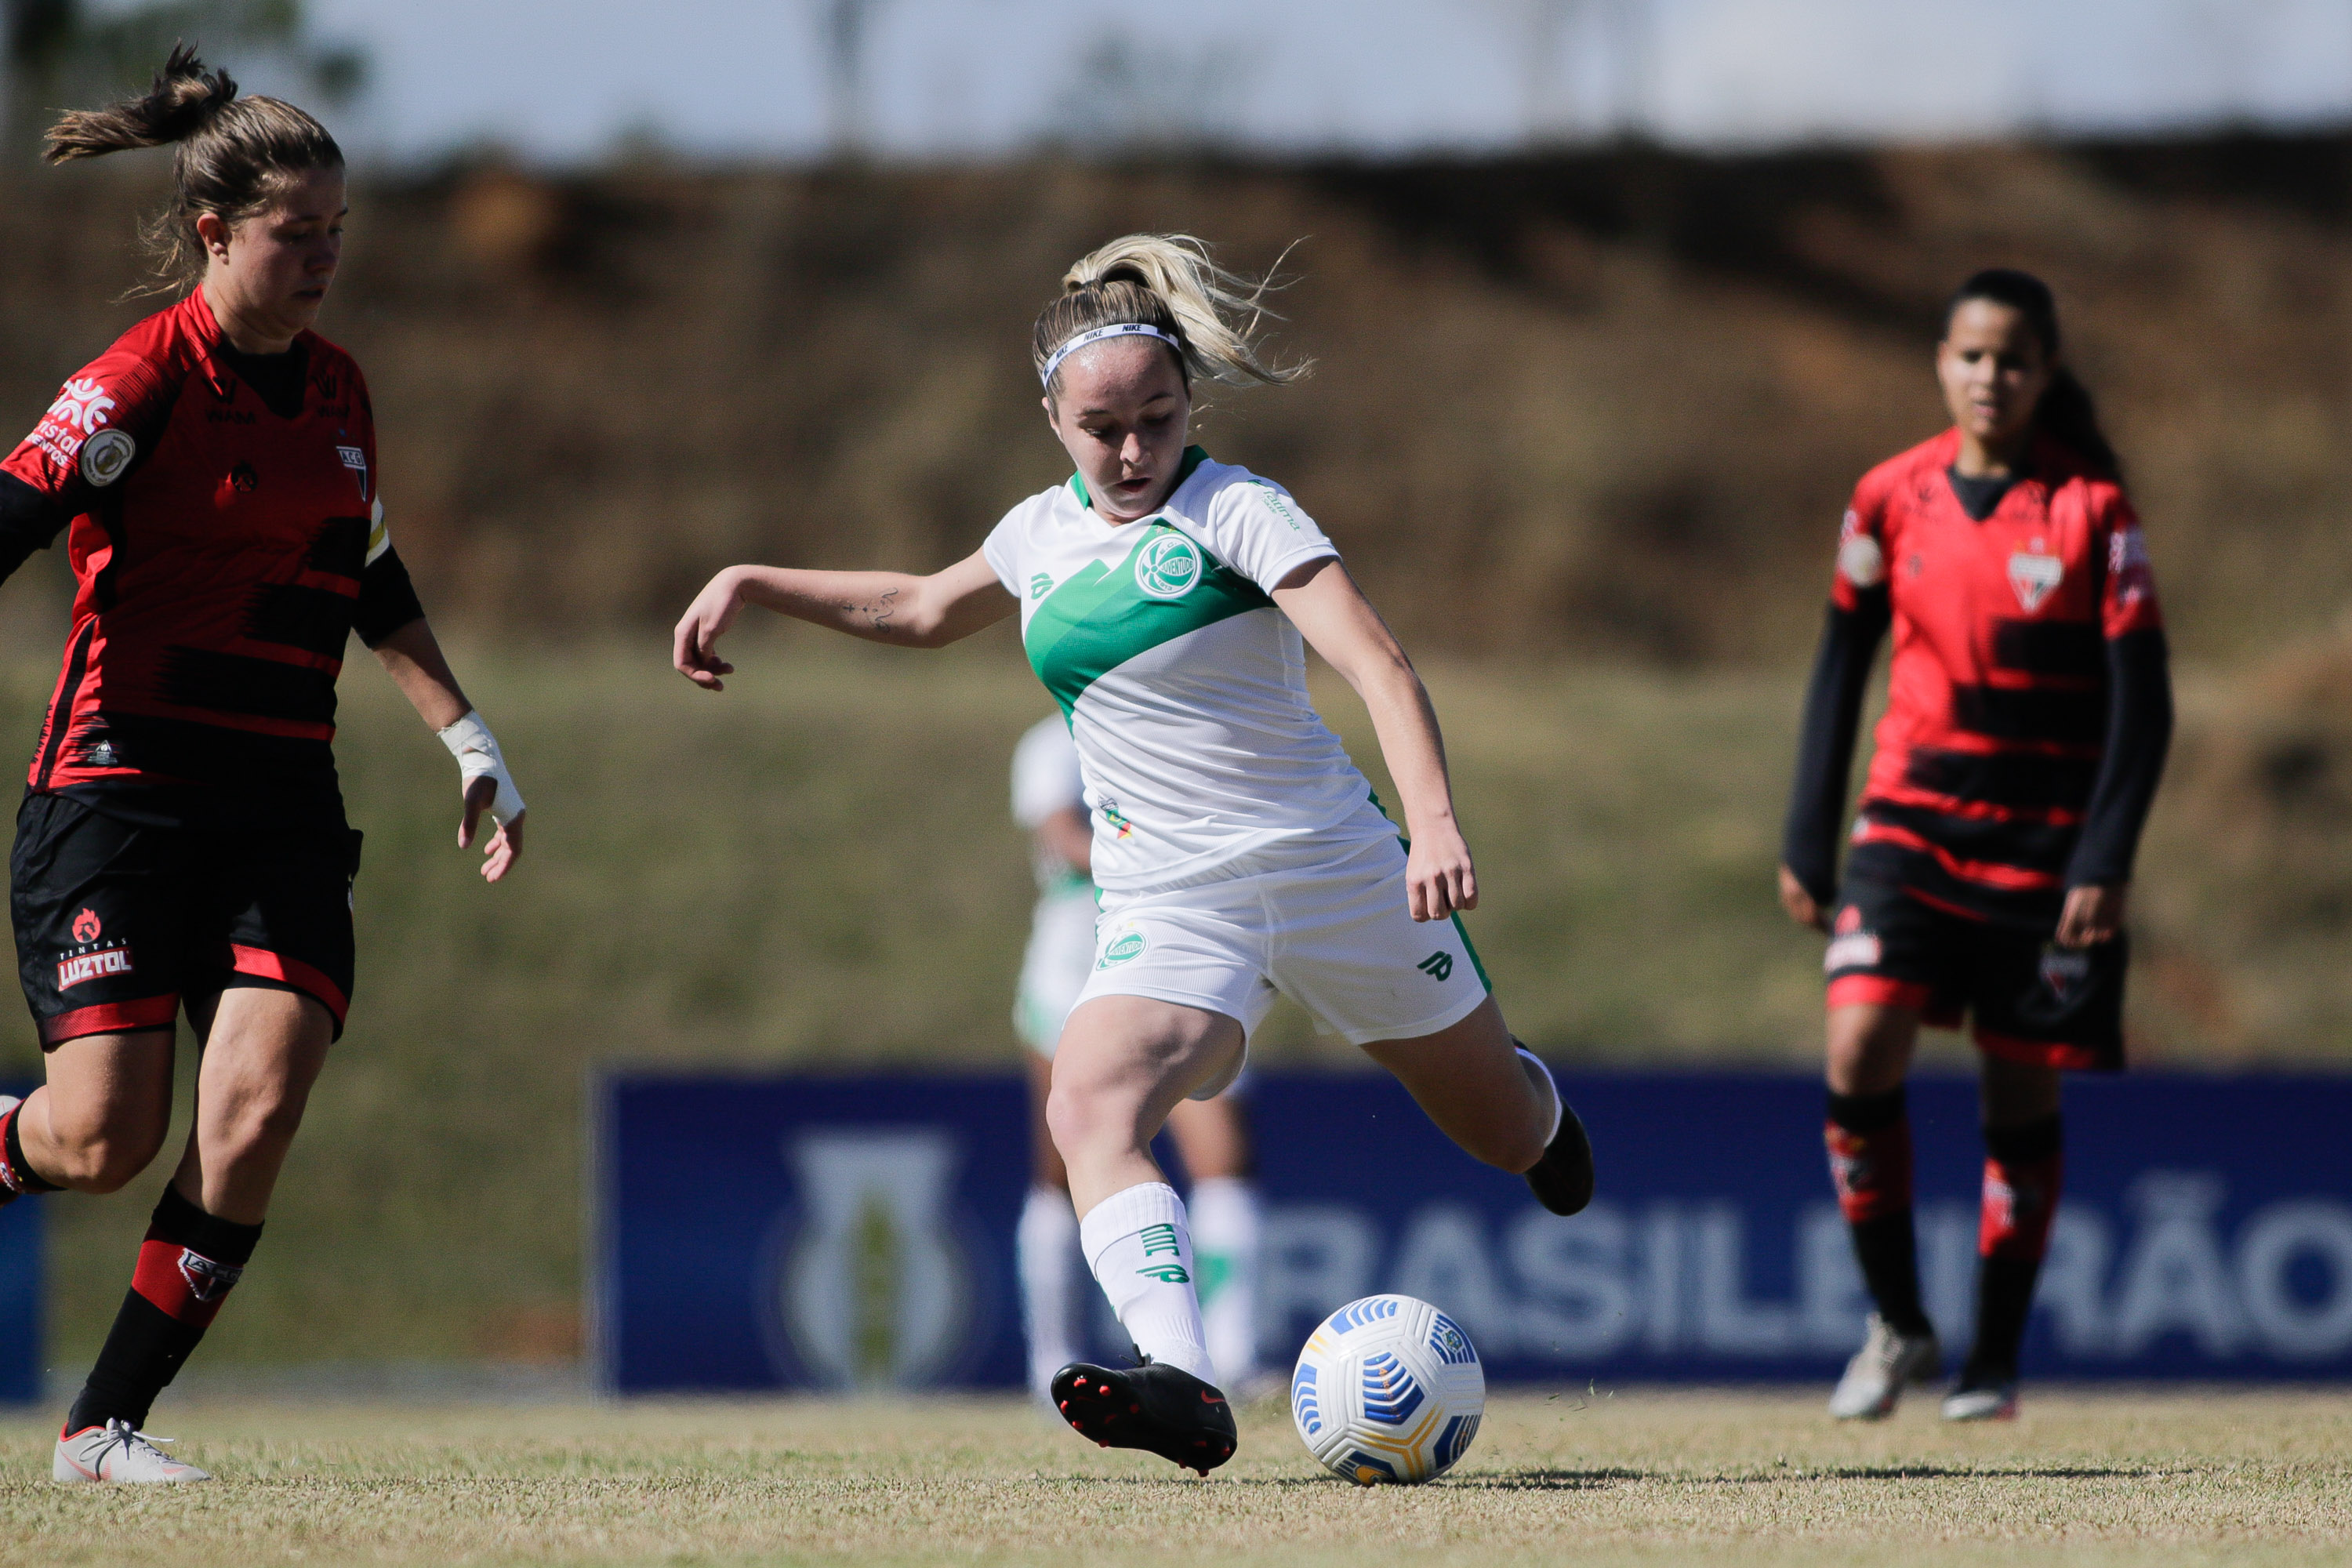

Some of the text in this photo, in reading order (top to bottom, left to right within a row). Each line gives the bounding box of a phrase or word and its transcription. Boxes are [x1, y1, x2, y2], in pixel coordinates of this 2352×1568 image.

[1083, 328, 1103, 342] NIKE
[1122, 324, 1142, 332] NIKE
[37, 419, 83, 456] ristal
[343, 452, 361, 465] ACG
[1161, 557, 1194, 575] JUVENTUDE
[60, 938, 126, 960] TINTAS
[60, 950, 132, 987] LUZTOL
